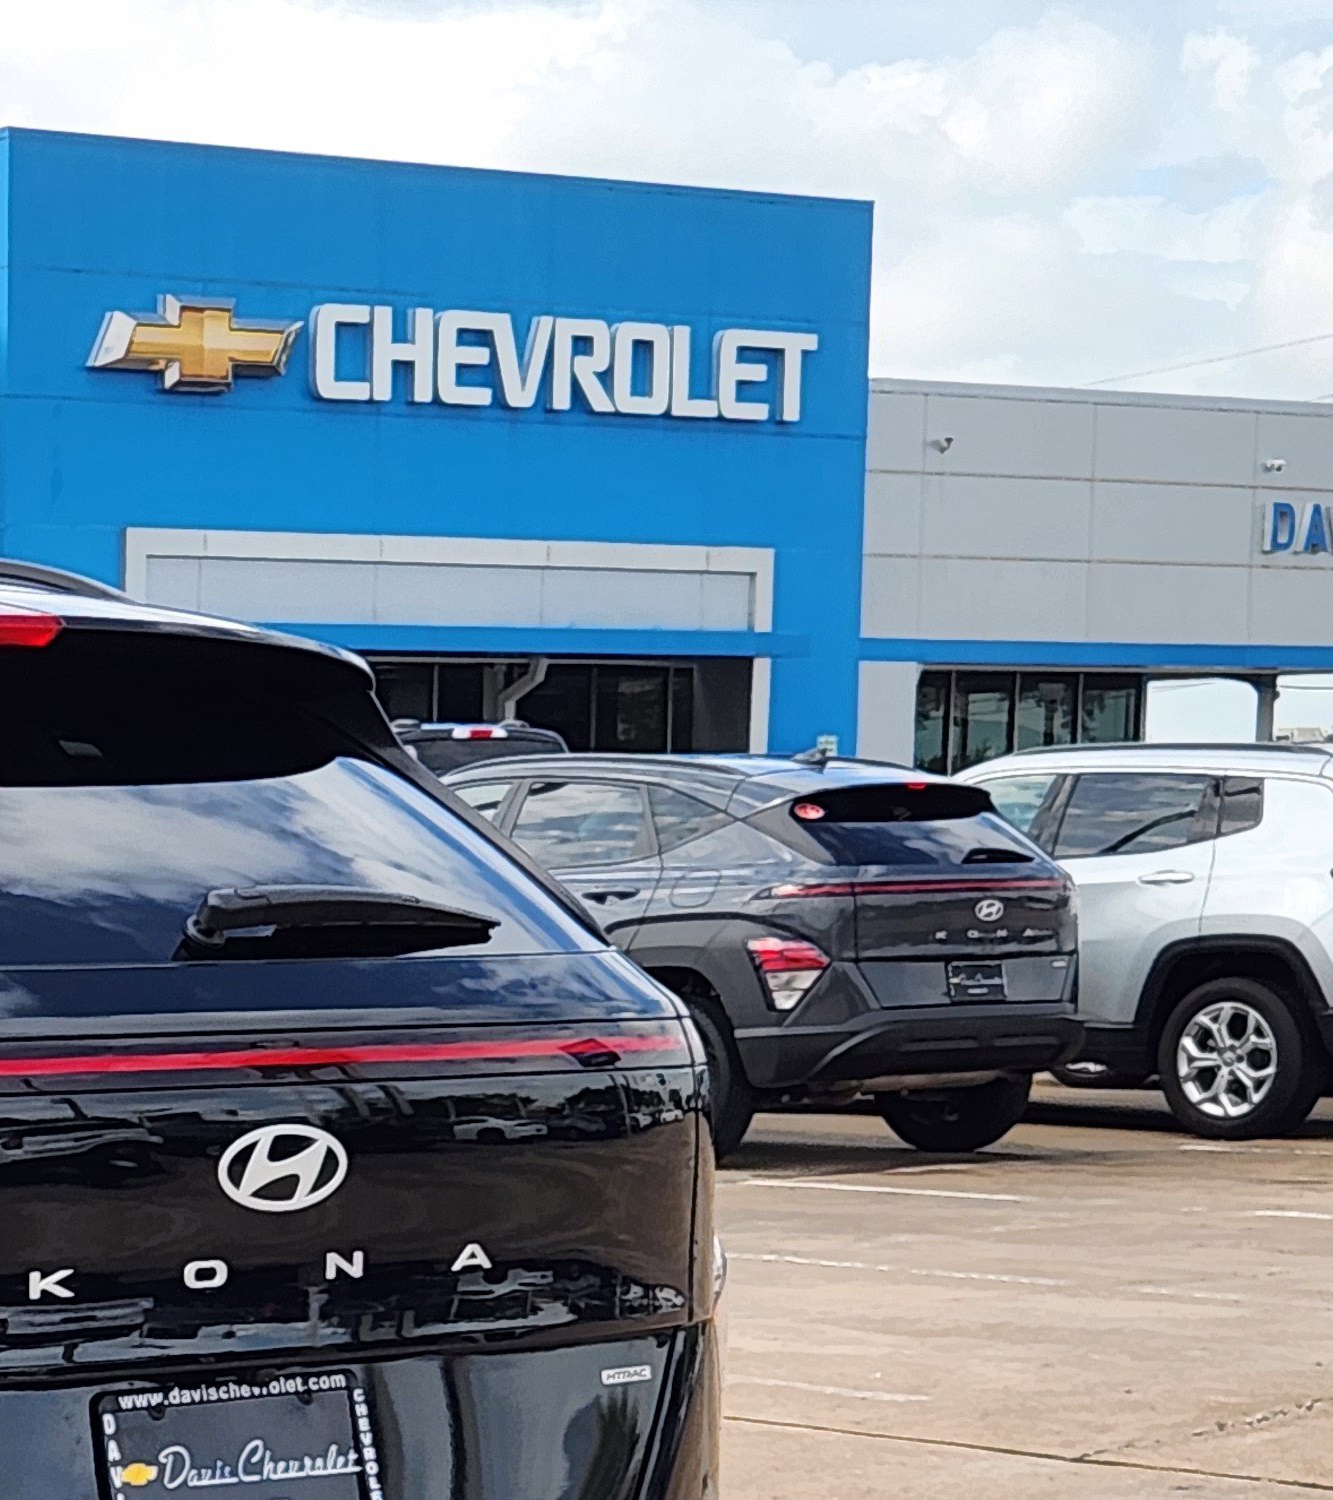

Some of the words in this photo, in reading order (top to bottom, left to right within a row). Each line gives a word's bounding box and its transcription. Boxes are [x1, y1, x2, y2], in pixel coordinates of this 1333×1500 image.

[309, 304, 819, 422] CHEVROLET
[1265, 502, 1333, 553] DA
[29, 1243, 493, 1299] KONA
[606, 1368, 648, 1381] HTRAC
[158, 1446, 239, 1489] Davis
[238, 1439, 364, 1482] Chevrolet
